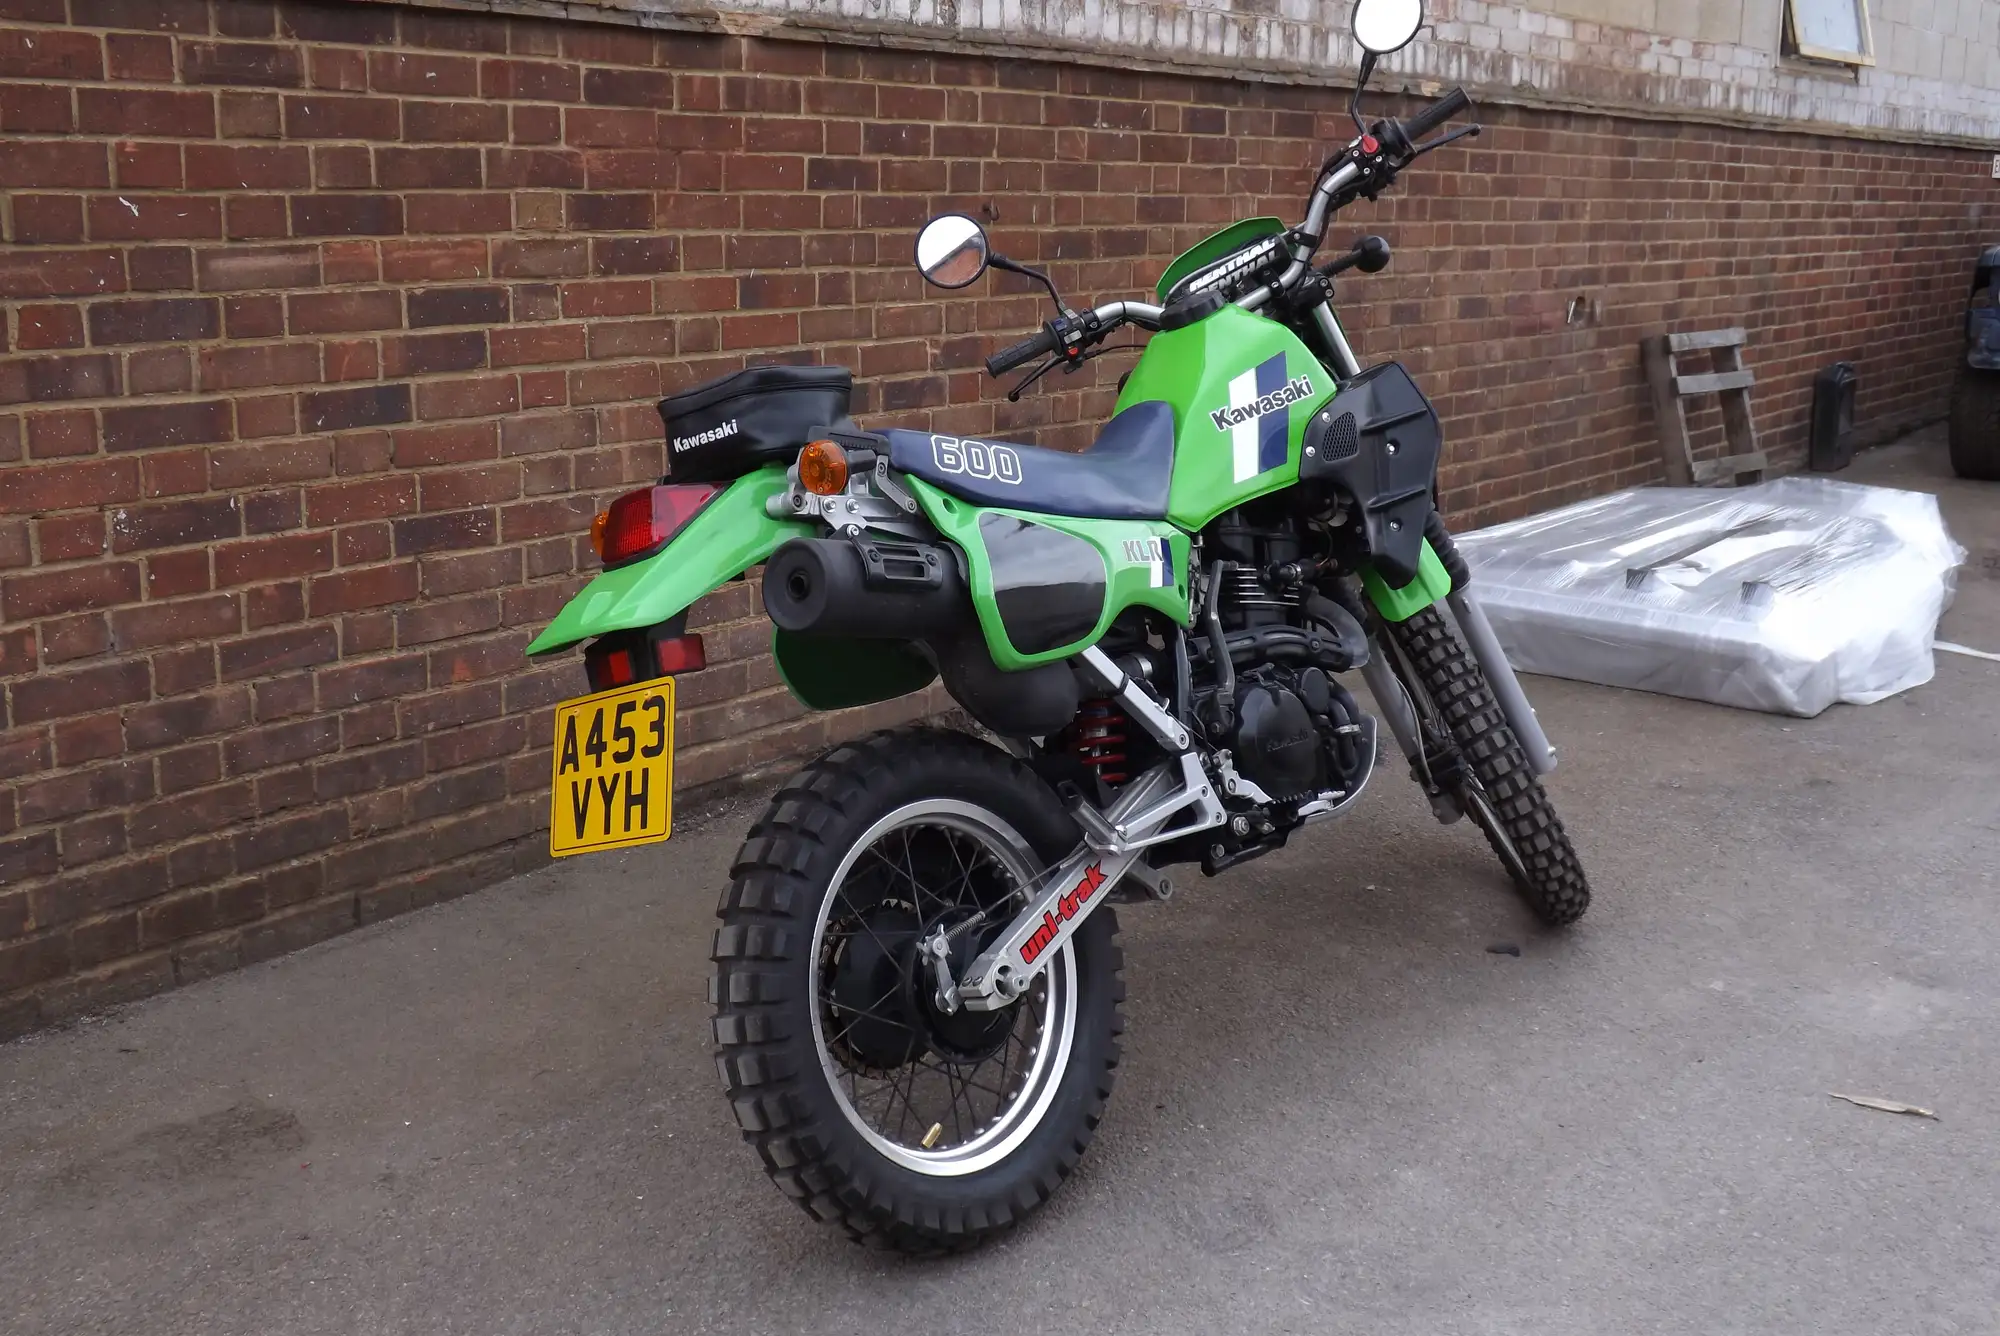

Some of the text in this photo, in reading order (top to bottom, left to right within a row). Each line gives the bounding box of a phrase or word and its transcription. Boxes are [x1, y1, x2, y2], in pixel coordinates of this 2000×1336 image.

[1190, 239, 1275, 292] RENTHAL
[1210, 375, 1313, 431] Kawasaki
[673, 419, 738, 453] Kawasaki
[930, 434, 1022, 485] 600
[1122, 539, 1164, 562] KLR
[559, 695, 666, 775] A453
[571, 767, 649, 840] VYH
